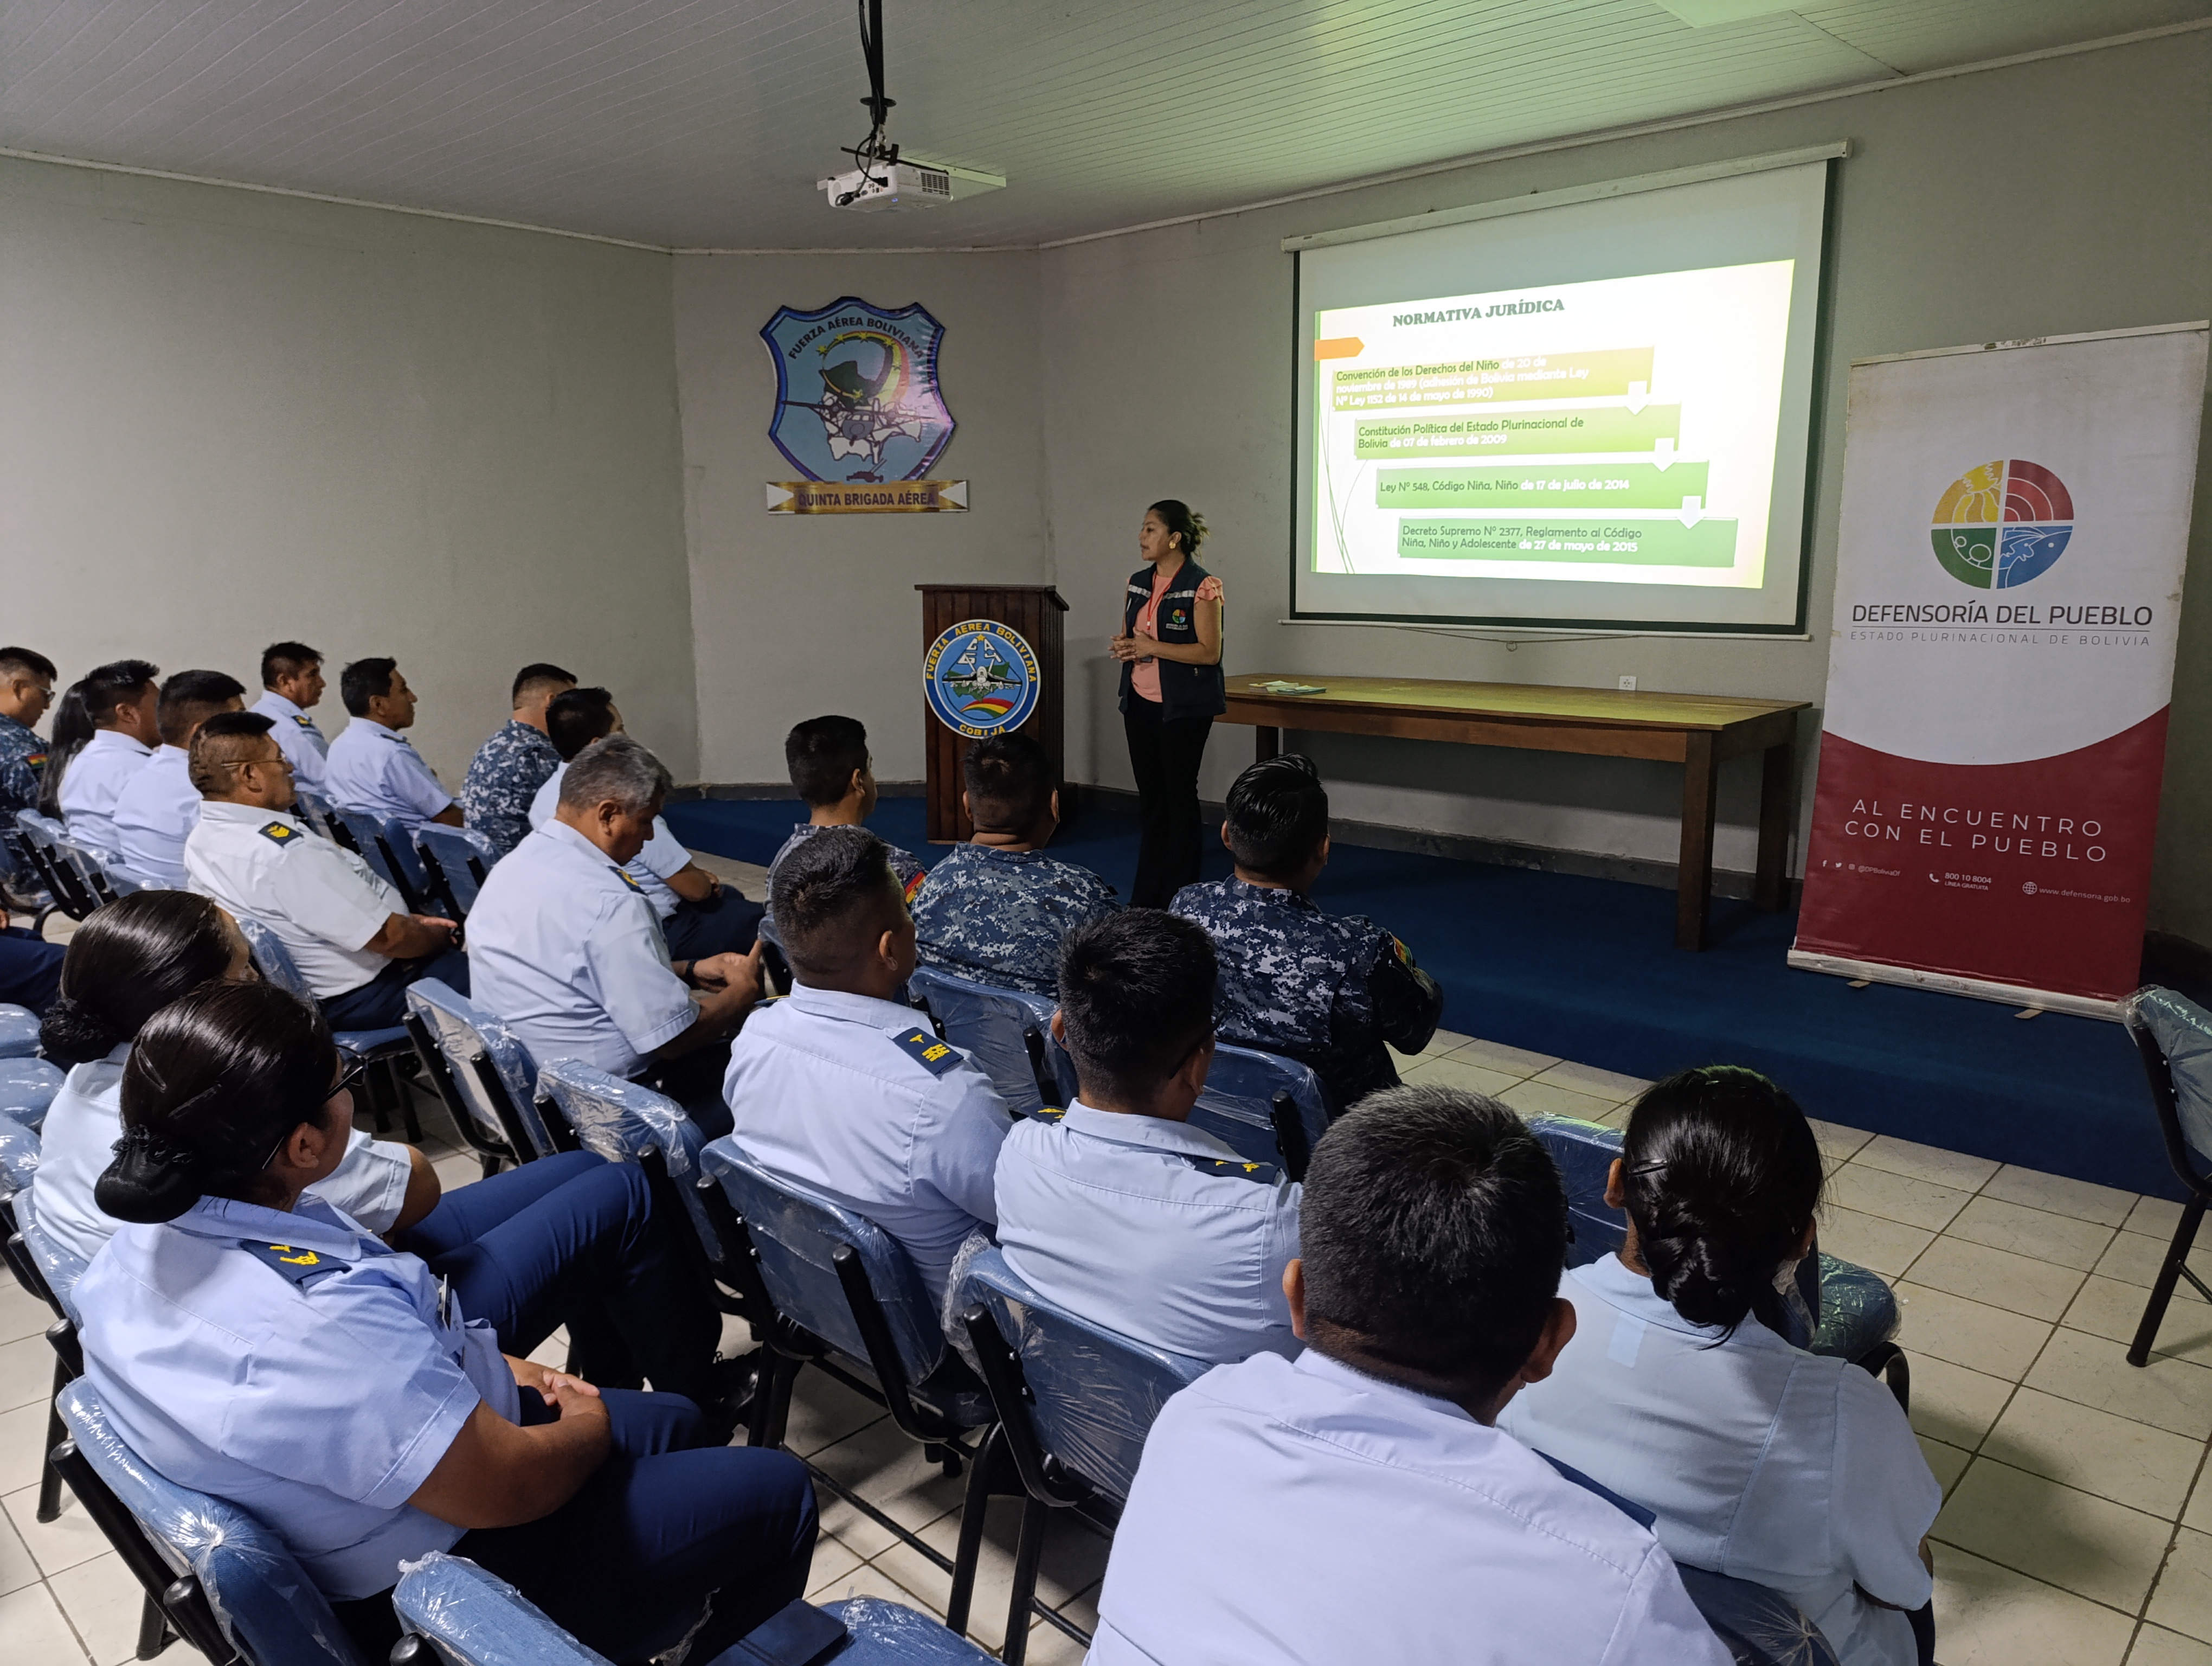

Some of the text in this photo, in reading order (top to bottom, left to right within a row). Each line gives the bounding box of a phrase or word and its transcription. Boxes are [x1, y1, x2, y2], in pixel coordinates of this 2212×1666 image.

[1393, 299, 1565, 327] NORMATIVA JURÍDICA
[788, 317, 924, 359] FUERZA AÉREA BOLIVIANA
[1336, 356, 1546, 381] Convención de los Derechos del Niño de 20 de
[1336, 367, 1589, 393] noviembre de 1989 (adhesión de Bolivia mediante Ley
[1349, 395, 1365, 407] Ley
[1367, 394, 1383, 403] 1152
[1385, 393, 1397, 402] de
[1399, 392, 1407, 402] 14
[1410, 390, 1422, 400] de
[1424, 390, 1450, 401] mayo
[1452, 388, 1464, 399] de
[1467, 387, 1493, 399] 1990)
[1359, 418, 1584, 437] Constitución Política del Estado Plurinacional de
[1358, 434, 1507, 448] Bolivia de 07 de febrero de 2009
[1380, 482, 1397, 494] Ley
[1412, 482, 1430, 492] 548,
[1432, 481, 1464, 494] Código
[1467, 480, 1493, 491] Niña,
[1495, 479, 1519, 490] Niño
[1520, 479, 1534, 490] de
[1536, 480, 1545, 490] 17
[1547, 479, 1561, 490] de
[1563, 479, 1586, 492] julio
[1588, 478, 1603, 489] de
[1605, 479, 1629, 490] 2014
[798, 490, 934, 507] QUINTA BRIGADA AÉREA
[1403, 526, 1438, 536] Decreto
[1441, 526, 1481, 538] Supremo
[1499, 528, 1523, 537] 2377,
[1526, 527, 1587, 540] Reglamento
[1590, 527, 1600, 537] al
[1604, 527, 1642, 540] Código
[1401, 539, 1638, 553] Niña, Niño y Adolescente de 27 de mayo de 2015
[1852, 600, 2153, 626] DEFENSORÍA DEL PUEBLO
[1850, 631, 2150, 646] ESTADO PLURINACIONAL DE BOLIVIA
[926, 623, 1037, 682] FUERZA AEREA BOLIVIANA
[960, 724, 1005, 736] COBIJA
[1852, 799, 2101, 837] AL ENCUENTRO
[1844, 821, 2106, 862] CON EL PUEBLO
[1944, 872, 1959, 881] 800
[1973, 875, 1992, 885] 8004
[1944, 880, 1989, 891] LÍNEA GRATUITA
